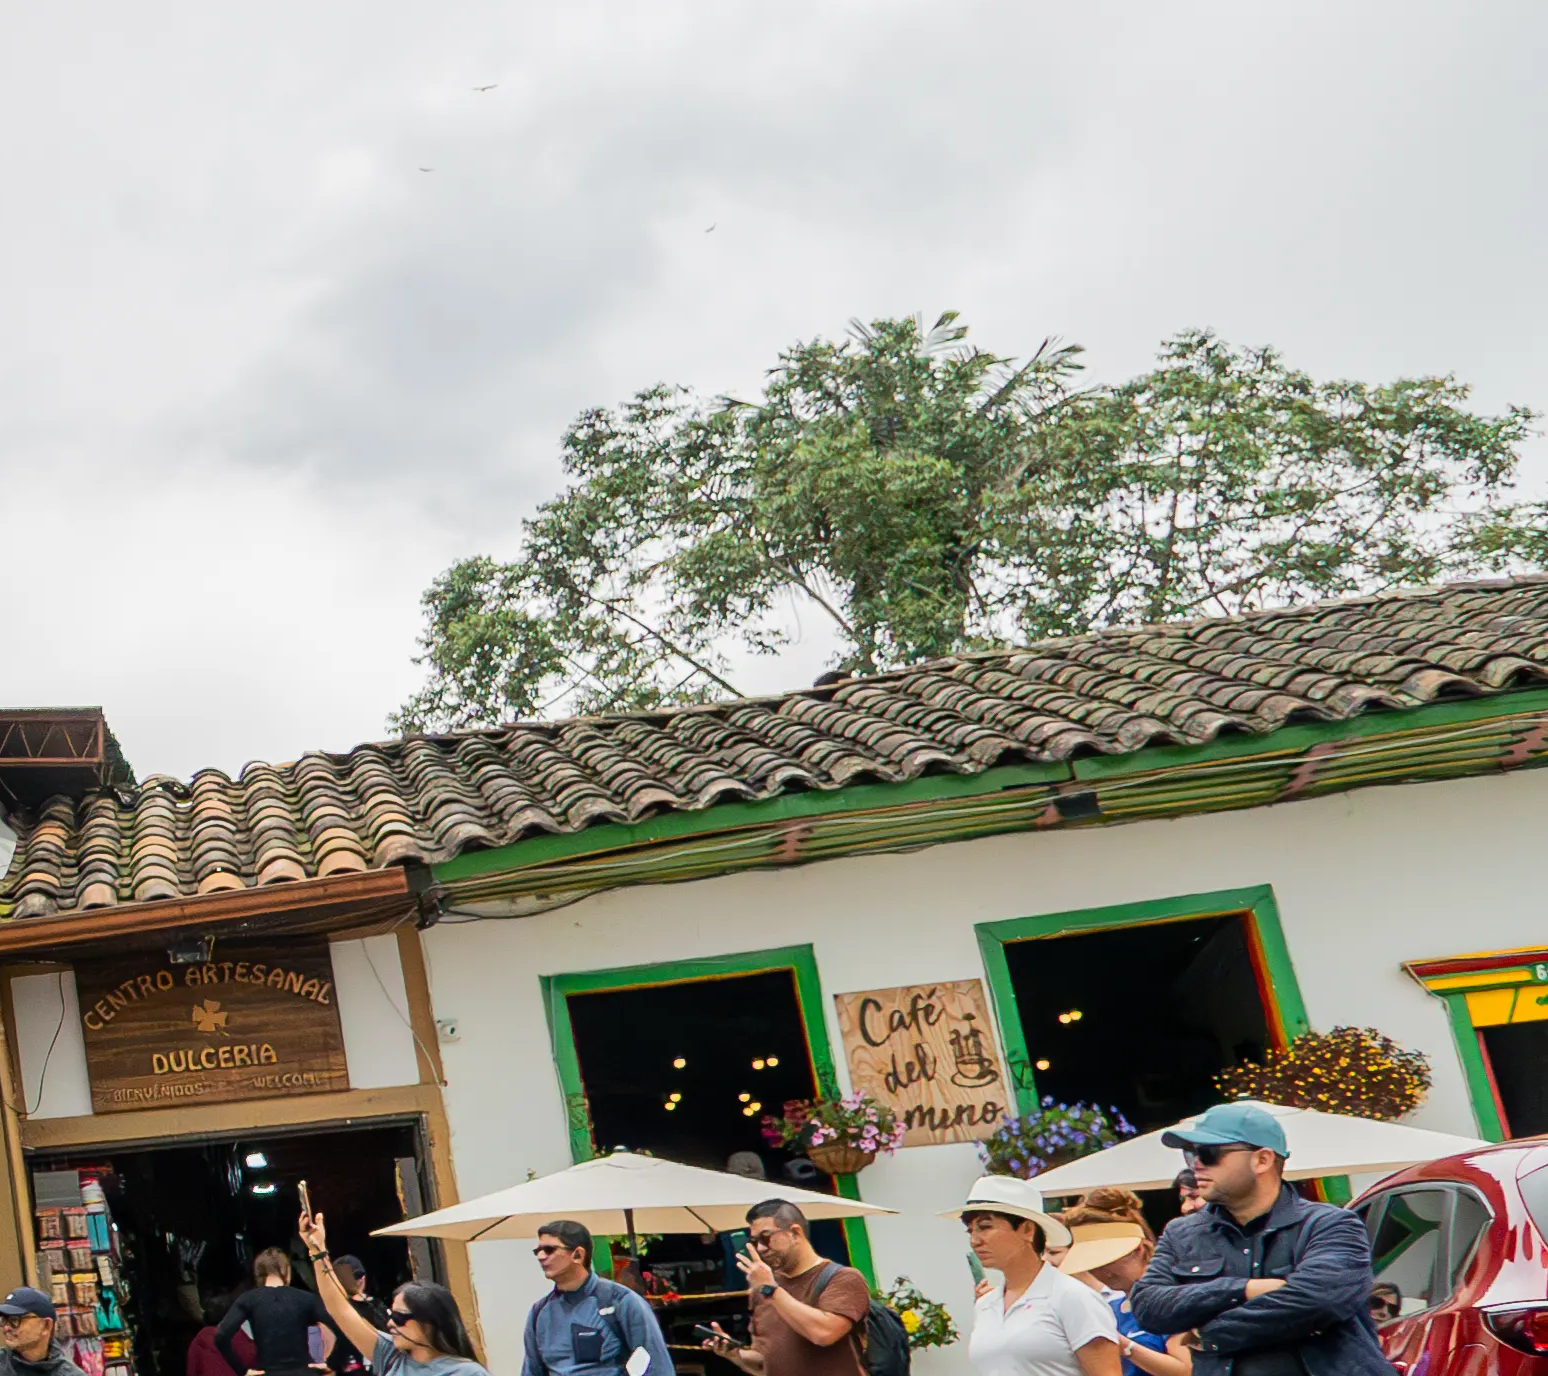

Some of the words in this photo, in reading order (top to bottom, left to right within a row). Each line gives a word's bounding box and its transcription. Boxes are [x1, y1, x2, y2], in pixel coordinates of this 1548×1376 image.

[84, 970, 174, 1031] CENTRO
[184, 962, 332, 1006] ARTESANAL
[859, 987, 945, 1047] Café
[152, 1043, 278, 1075] DULCERIA
[885, 1043, 937, 1094] del
[904, 1101, 1005, 1132] mino
